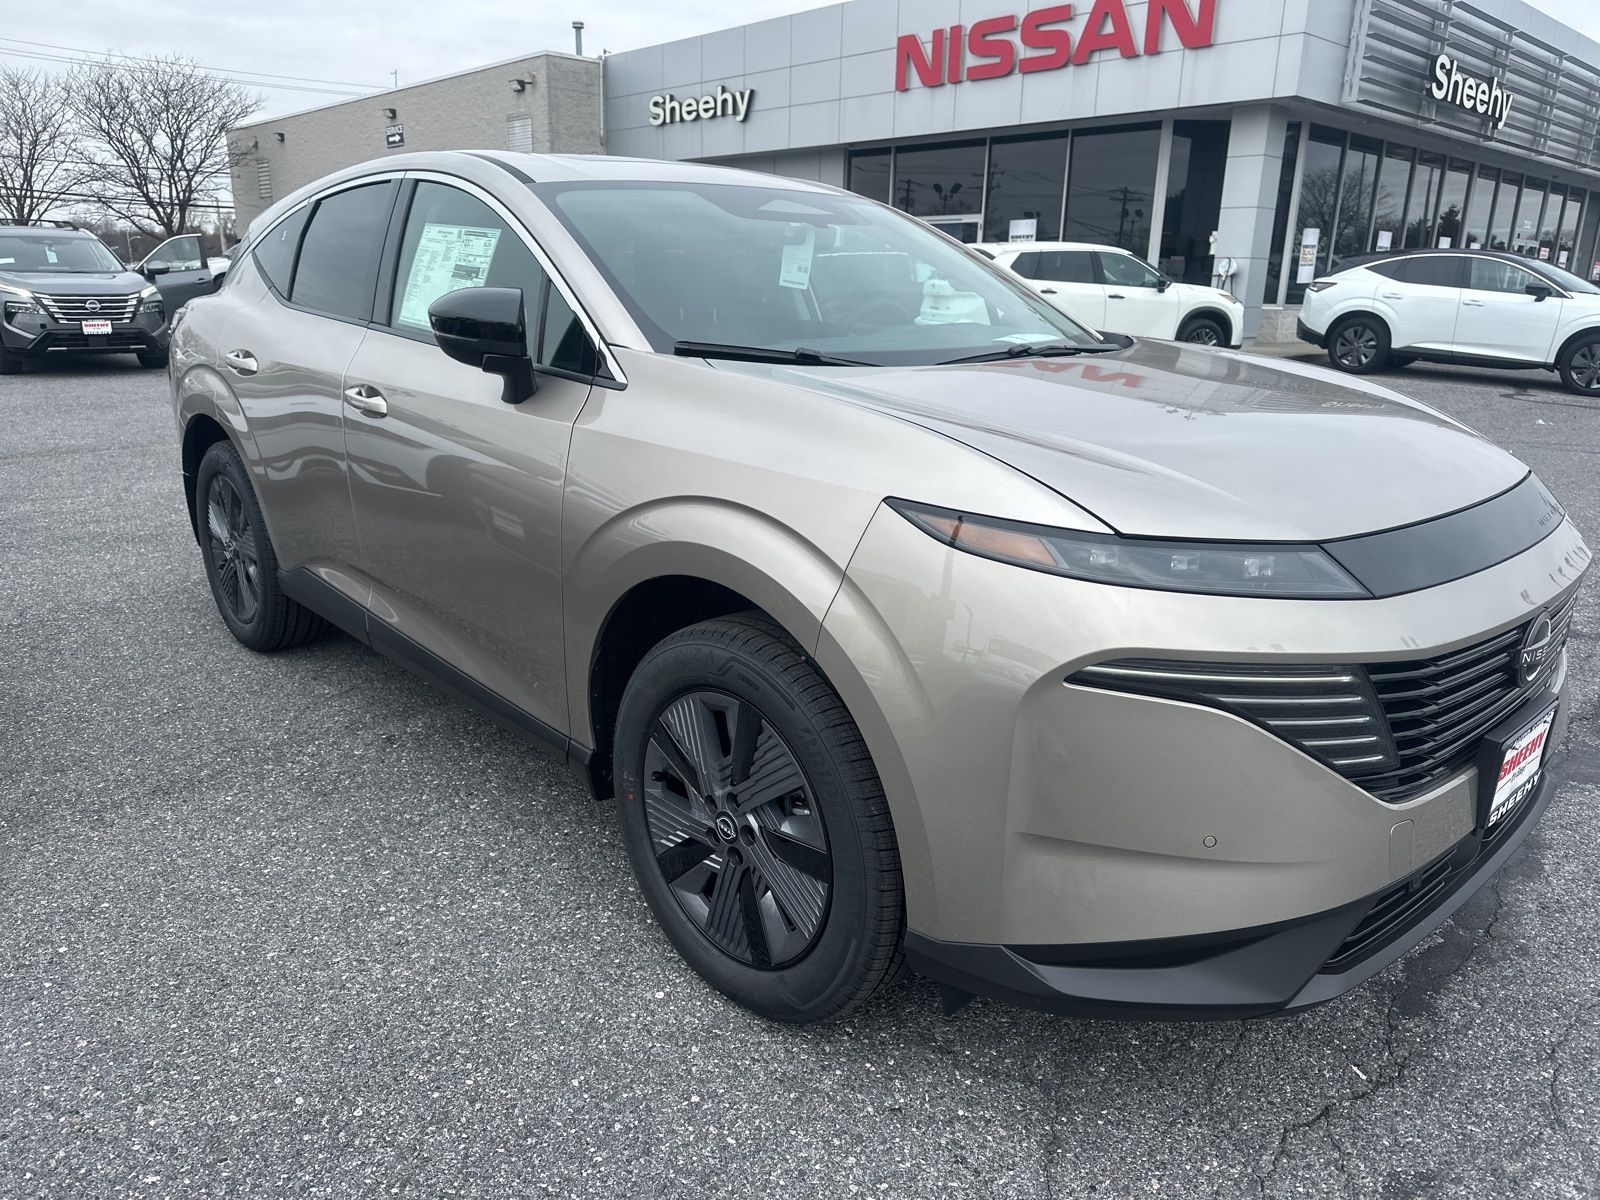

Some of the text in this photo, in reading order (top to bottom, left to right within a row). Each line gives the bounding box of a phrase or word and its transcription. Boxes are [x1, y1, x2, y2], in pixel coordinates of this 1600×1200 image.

[895, 0, 1216, 92] NISSAN
[648, 85, 753, 126] Sheehy
[1431, 54, 1514, 130] Sheehy
[1521, 645, 1548, 663] NISS
[1498, 727, 1548, 782] SHEEHY
[1487, 769, 1543, 828] SHEEHY
